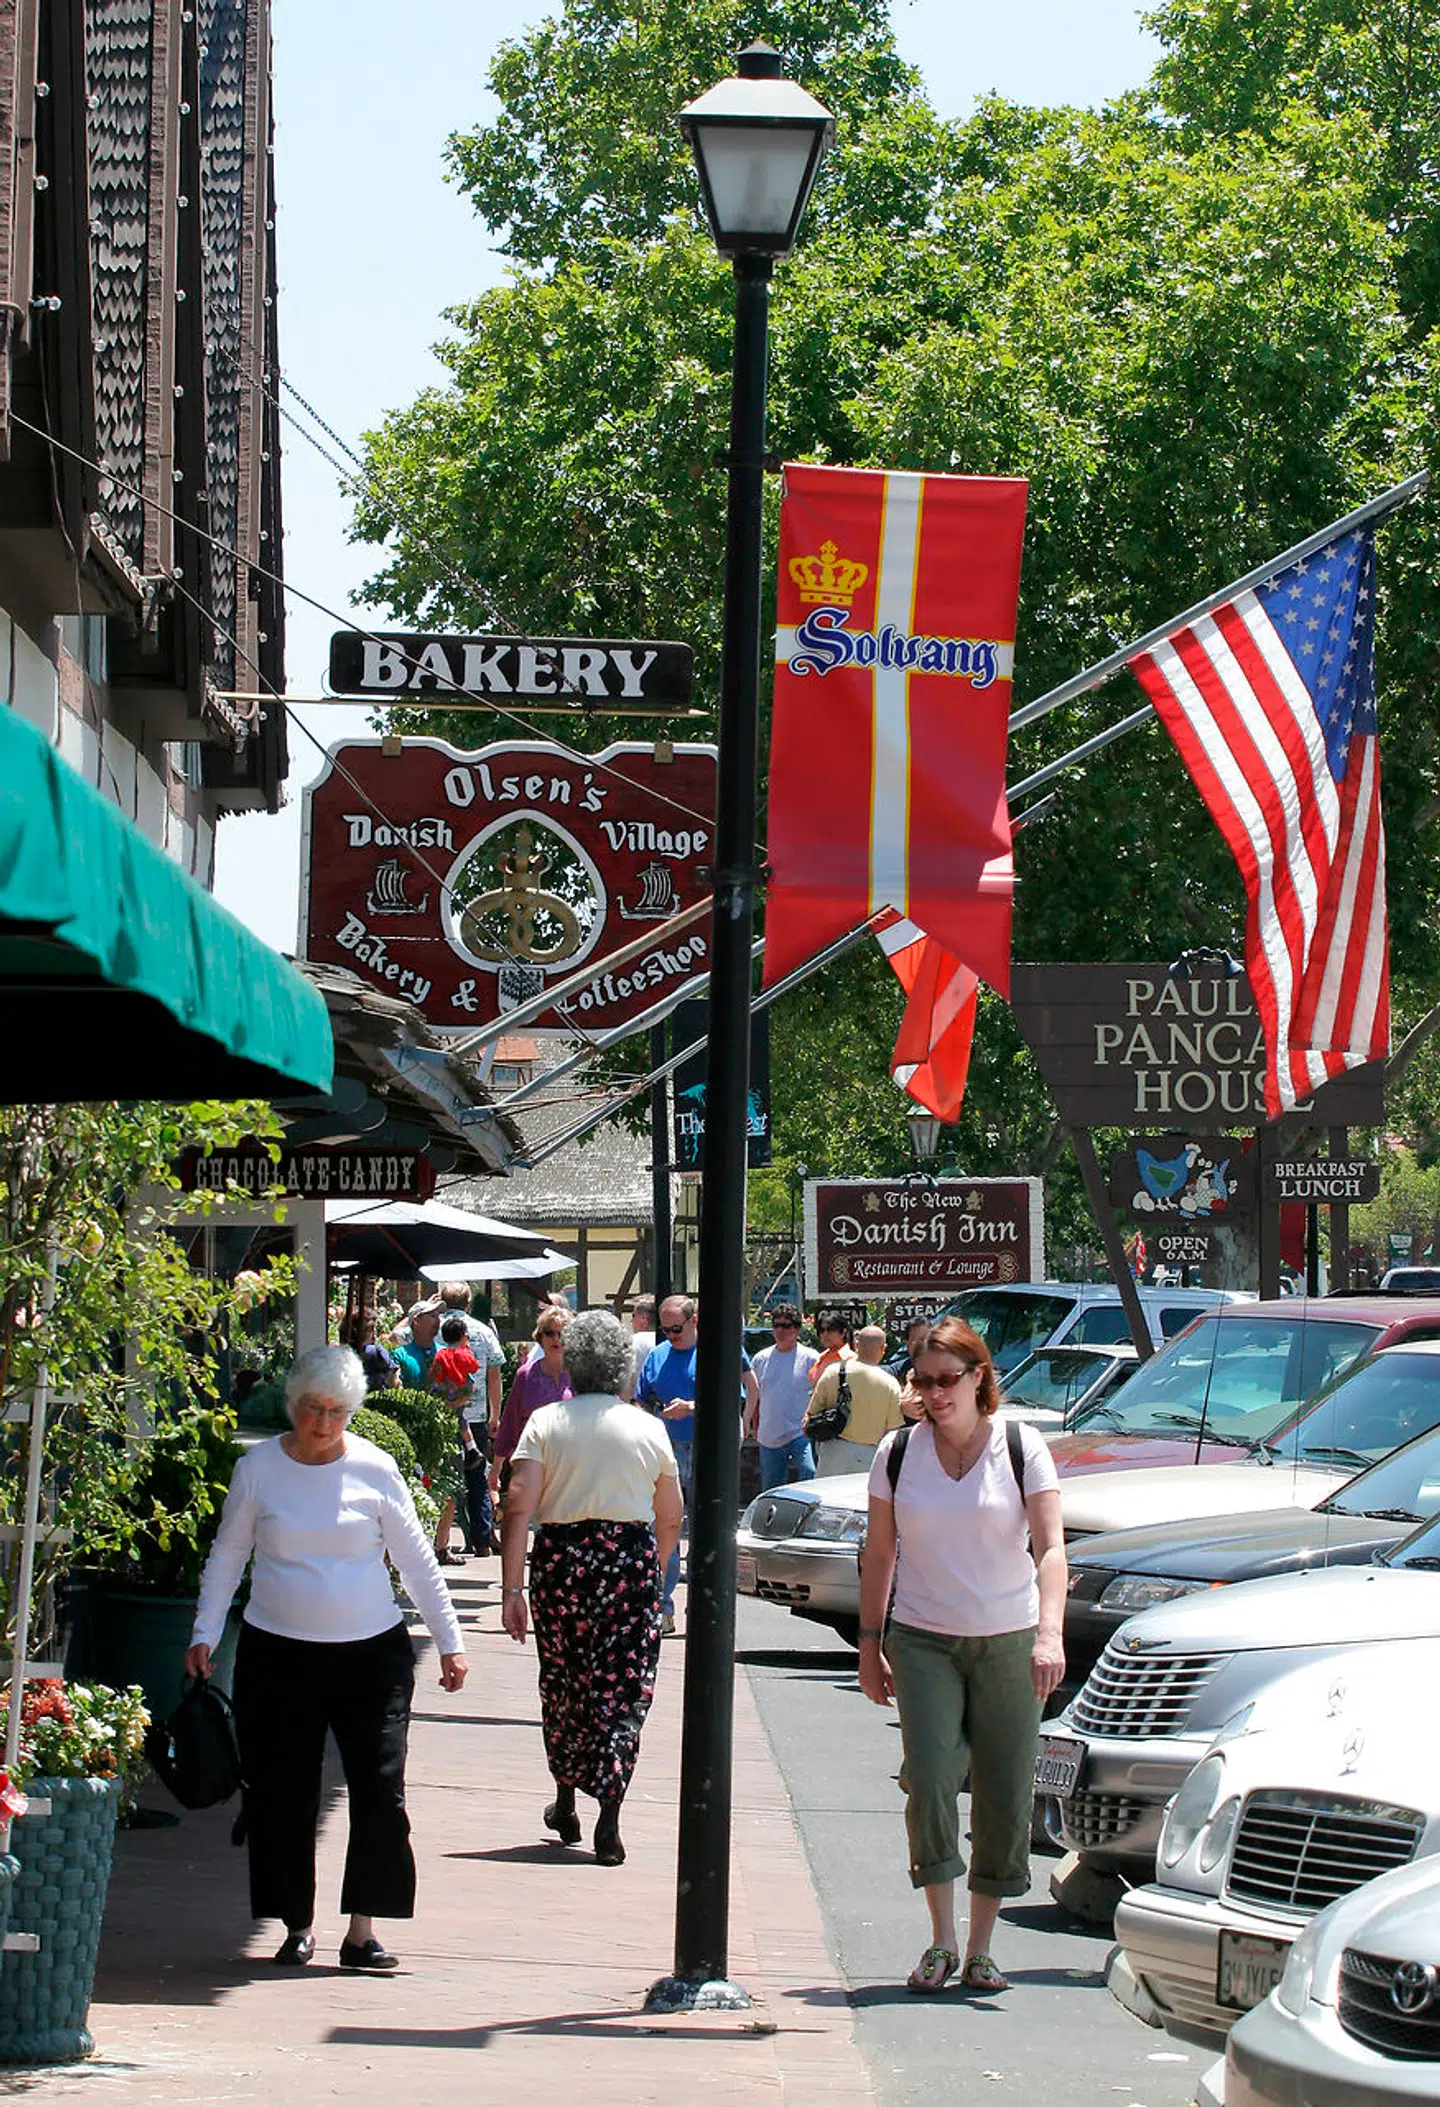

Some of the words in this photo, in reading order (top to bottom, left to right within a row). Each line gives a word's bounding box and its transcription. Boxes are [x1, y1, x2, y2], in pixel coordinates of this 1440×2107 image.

[789, 607, 1000, 689] Solvang
[360, 640, 658, 698] BAKERY
[444, 764, 607, 812] Olsen's
[342, 814, 459, 854] Danish
[599, 821, 709, 859] Village
[336, 911, 431, 1004] Bakery
[451, 979, 478, 1012] &
[1125, 979, 1260, 1017] PAUL
[1094, 1022, 1266, 1065] PANCA
[1275, 1162, 1366, 1177] BREAKFAST
[1280, 1180, 1361, 1197] LUNCH
[883, 1191, 918, 1212] The
[921, 1192, 962, 1209] New
[829, 1212, 947, 1251] Danish
[958, 1213, 1019, 1243] Inn
[1158, 1236, 1209, 1250] OPEN
[853, 1257, 925, 1279] Restaurant
[928, 1259, 944, 1275] &
[946, 1258, 995, 1280] Lounge
